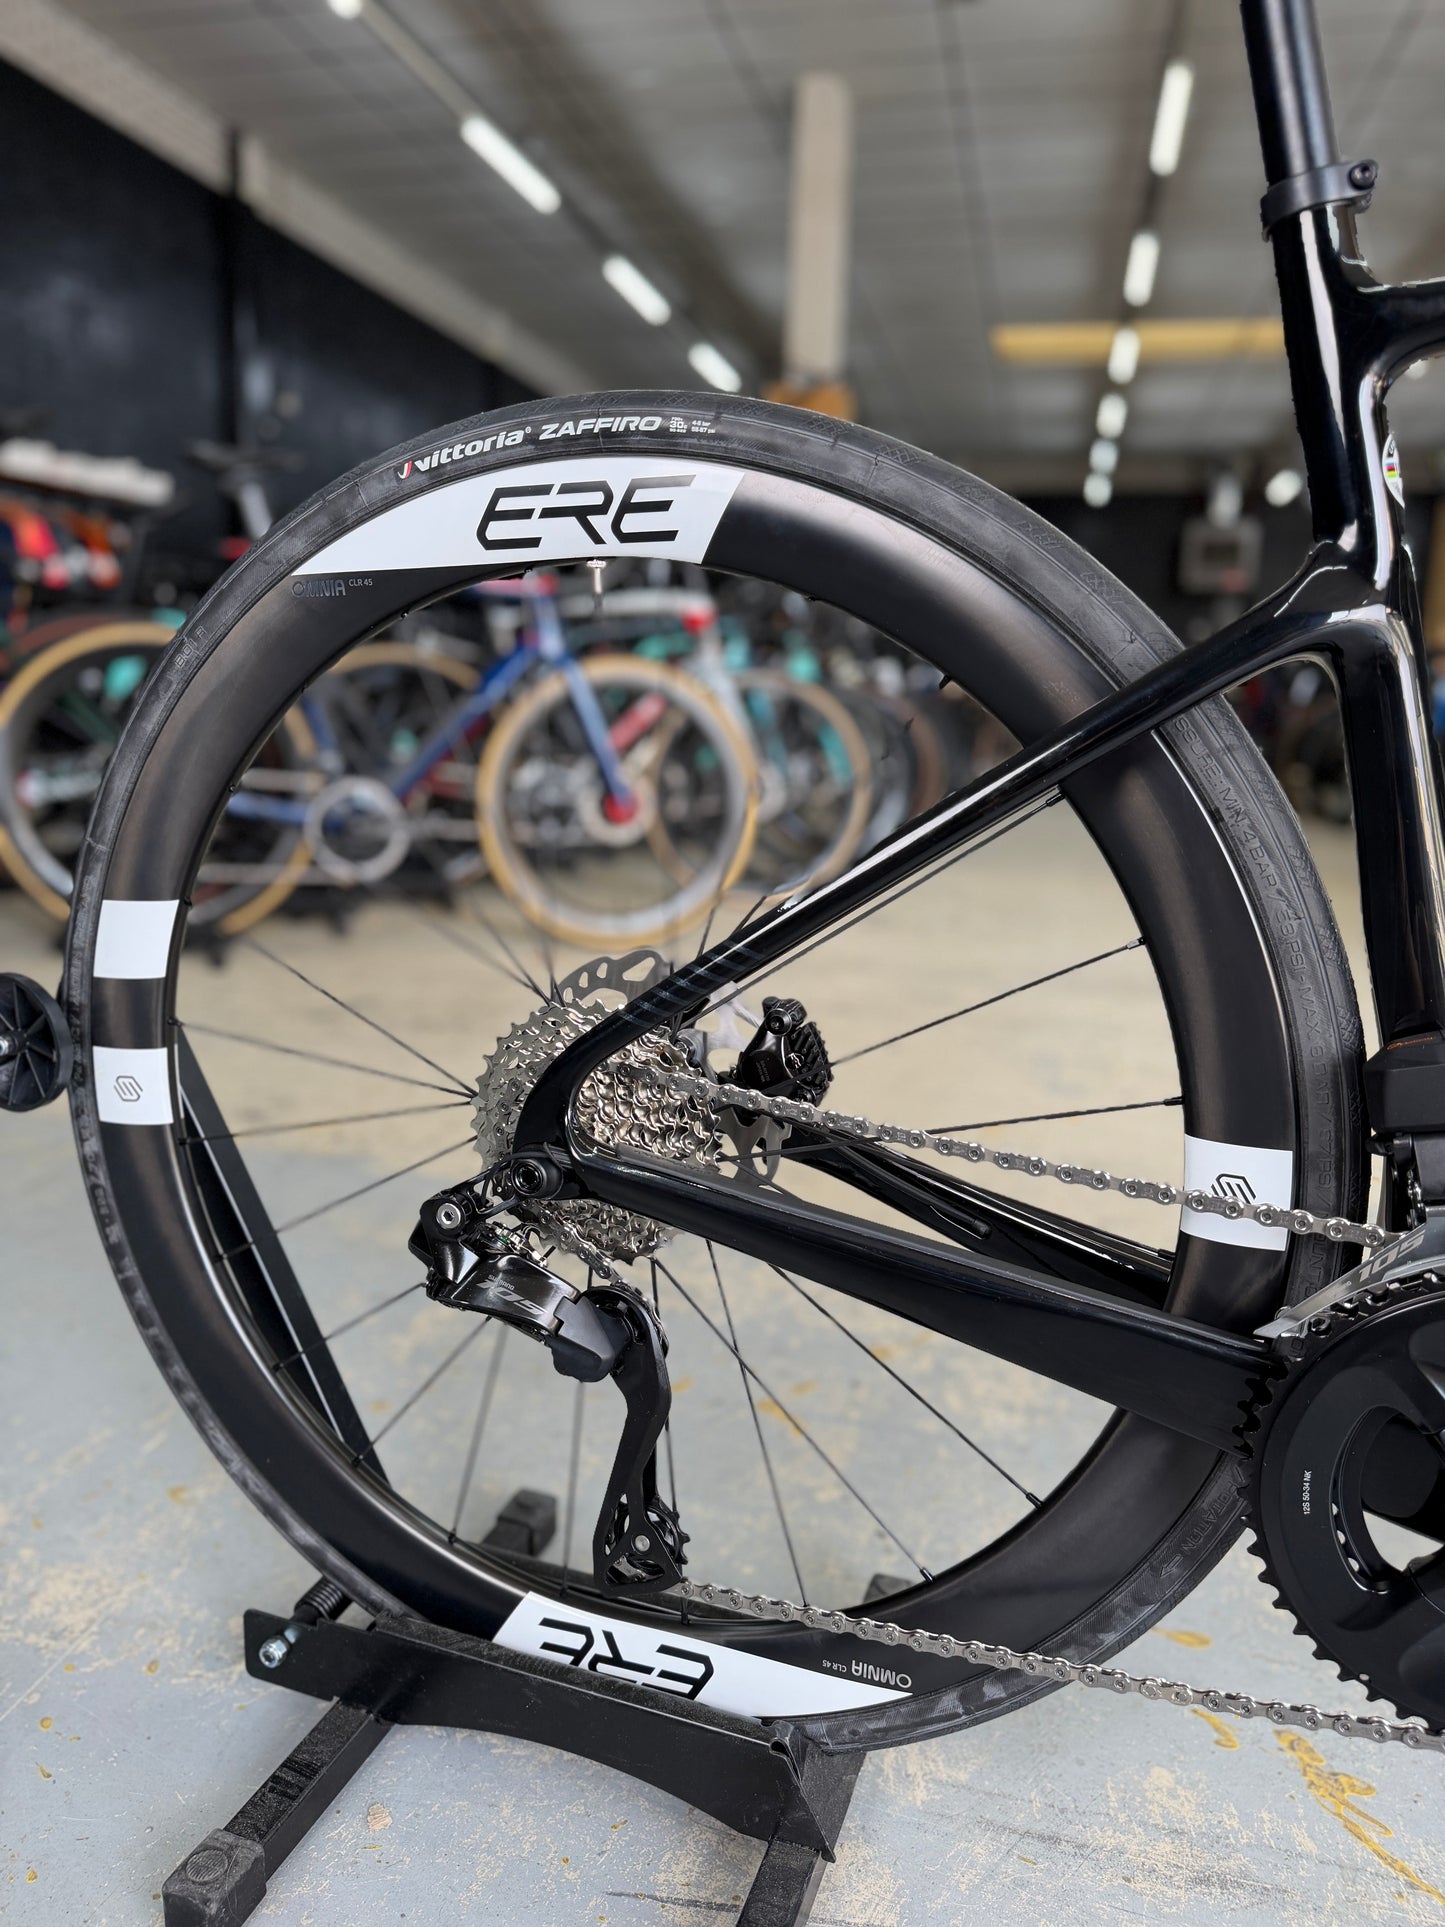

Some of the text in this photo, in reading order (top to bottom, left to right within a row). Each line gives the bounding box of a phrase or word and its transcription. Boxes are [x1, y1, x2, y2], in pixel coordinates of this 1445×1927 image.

[539, 416, 662, 441] ZAFFIRO
[476, 474, 697, 551] ERE
[291, 578, 373, 598] OMNIA CLR 45
[1359, 1229, 1426, 1282] 105
[476, 1279, 549, 1315] 105
[1302, 1470, 1312, 1515] 12S 50-34 NK
[538, 1617, 714, 1700] ERE
[822, 1659, 912, 1688] OMNIA CLR 45
